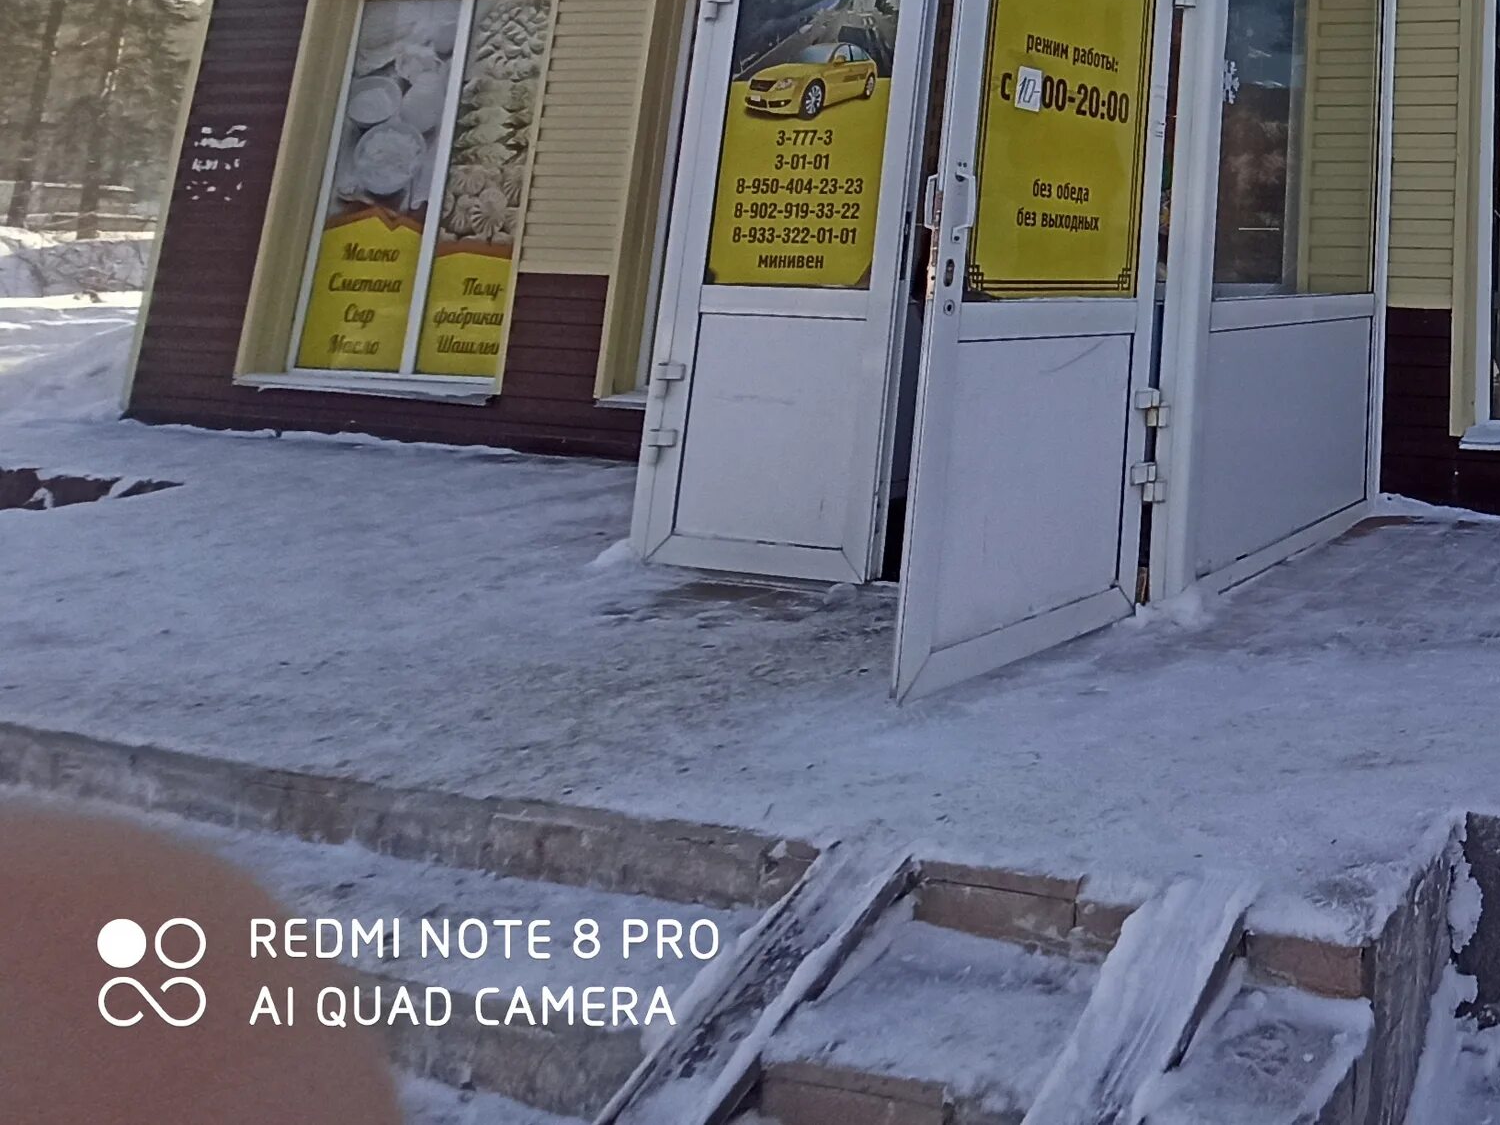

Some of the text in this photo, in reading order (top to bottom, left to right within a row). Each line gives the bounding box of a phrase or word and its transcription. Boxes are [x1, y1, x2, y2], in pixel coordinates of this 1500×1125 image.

[1026, 34, 1119, 73] режим работы:
[775, 129, 834, 146] 3-777-3
[774, 153, 830, 170] 3-01-01
[735, 177, 864, 195] 8-950-404-23-23
[1032, 178, 1090, 204] без обеда
[733, 201, 860, 220] 8-902-919-33-22
[1016, 207, 1100, 232] без выходных
[732, 226, 857, 245] 8-933-322-01-01
[342, 242, 400, 263] Молоко
[757, 254, 824, 269] минивен
[328, 272, 403, 293] Сметана
[462, 276, 504, 301] Полу-
[343, 303, 376, 329] Сыр
[327, 334, 380, 355] Масло
[437, 335, 500, 356] Шашлы
